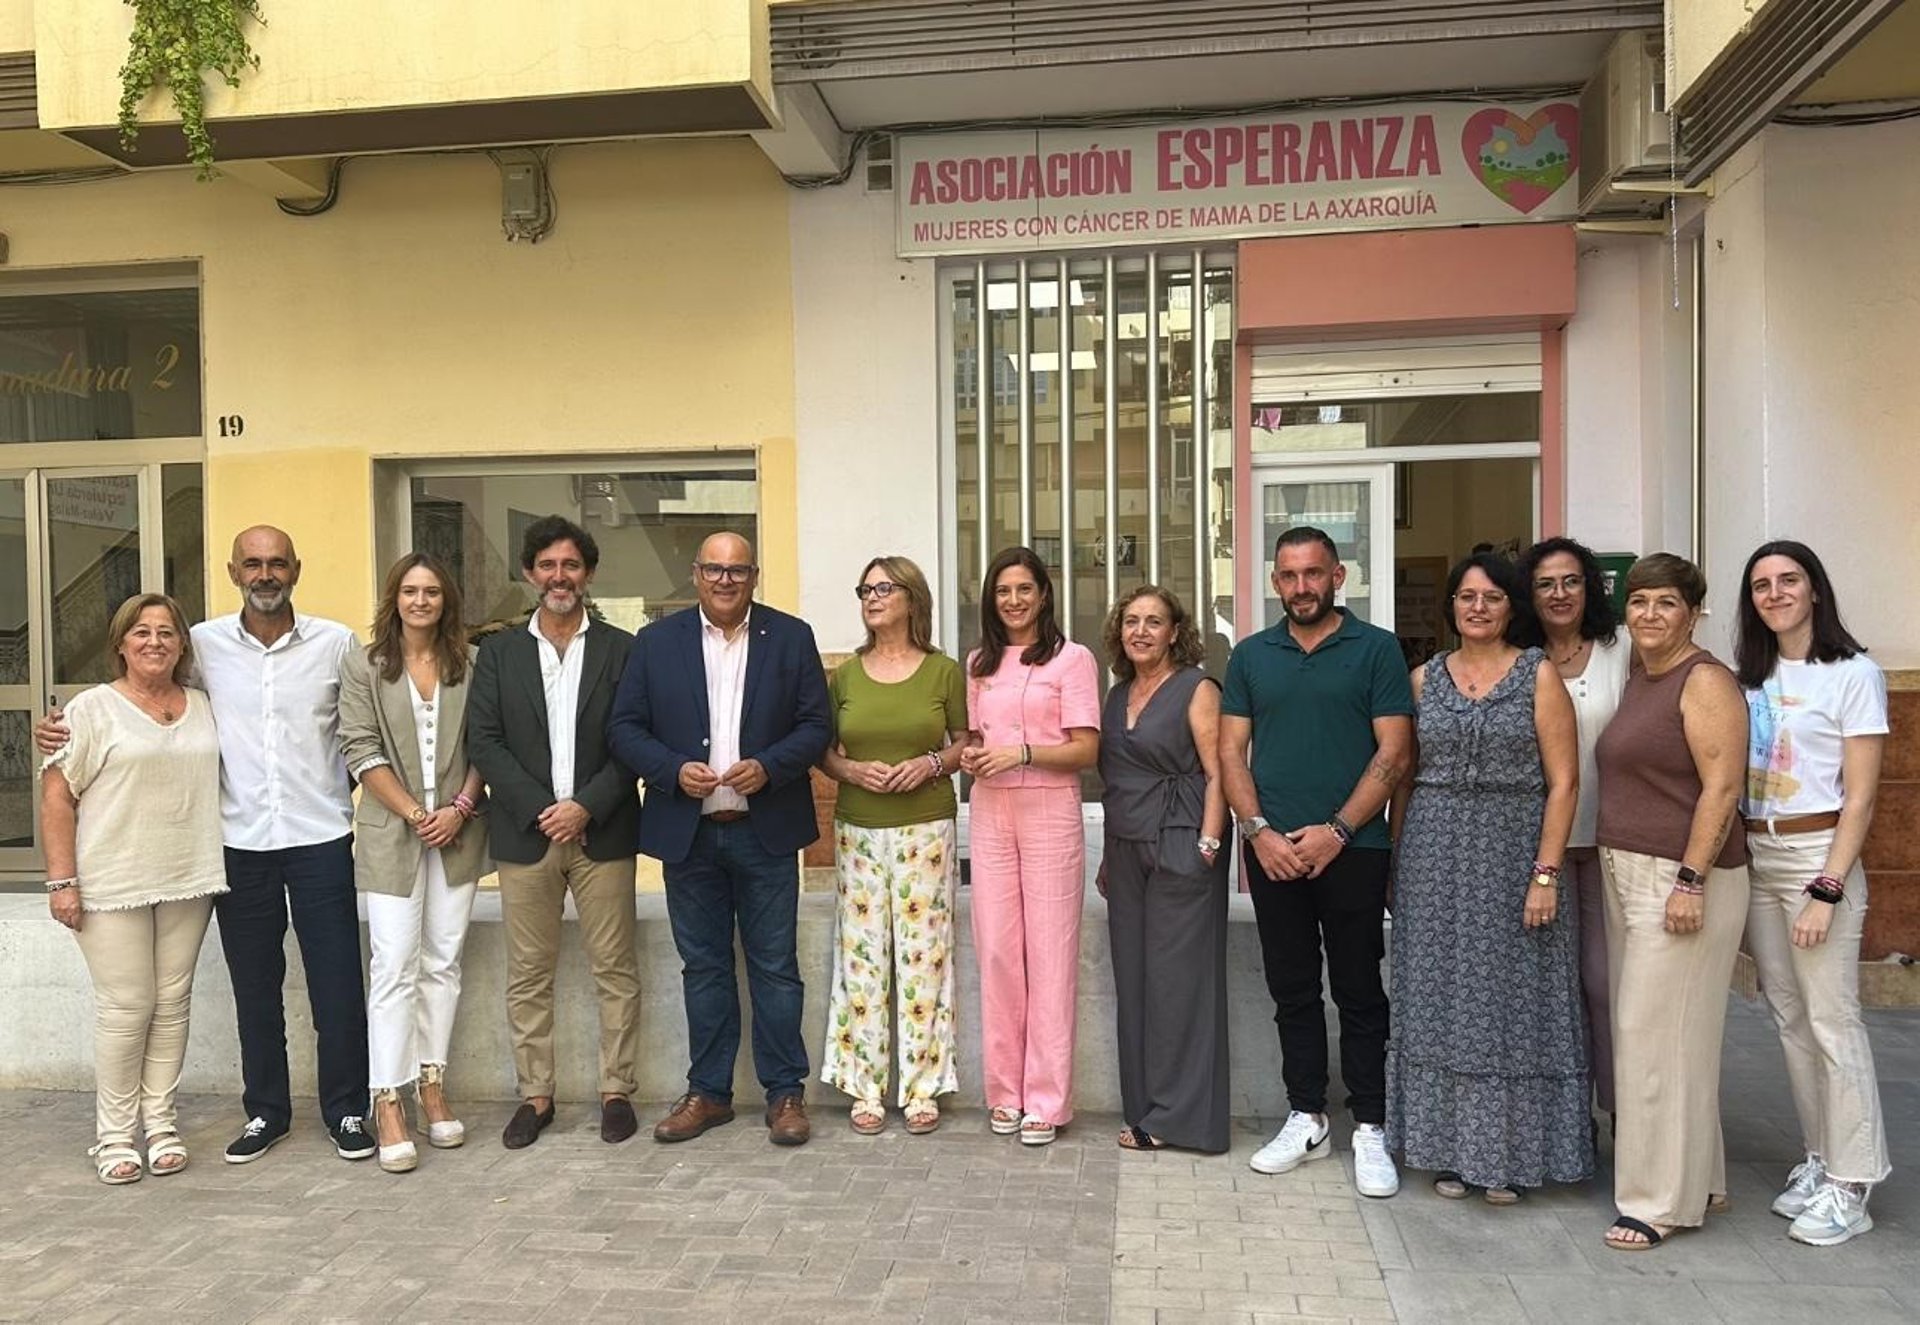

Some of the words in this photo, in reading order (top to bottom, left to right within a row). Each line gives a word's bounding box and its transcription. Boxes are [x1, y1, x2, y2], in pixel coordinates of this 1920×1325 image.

[910, 144, 1132, 205] ASOCIACIÓN
[1157, 114, 1441, 191] ESPERANZA
[914, 218, 1008, 242] MUJERES
[1014, 216, 1058, 238] CON
[1064, 209, 1149, 235] CÁNCER
[1156, 208, 1183, 229] DE
[1190, 204, 1253, 227] MAMA
[1258, 202, 1286, 223] DE
[1293, 200, 1320, 221] LA
[1325, 190, 1437, 219] AXARQUÍA
[152, 344, 180, 389] 2
[218, 415, 244, 438] 19
